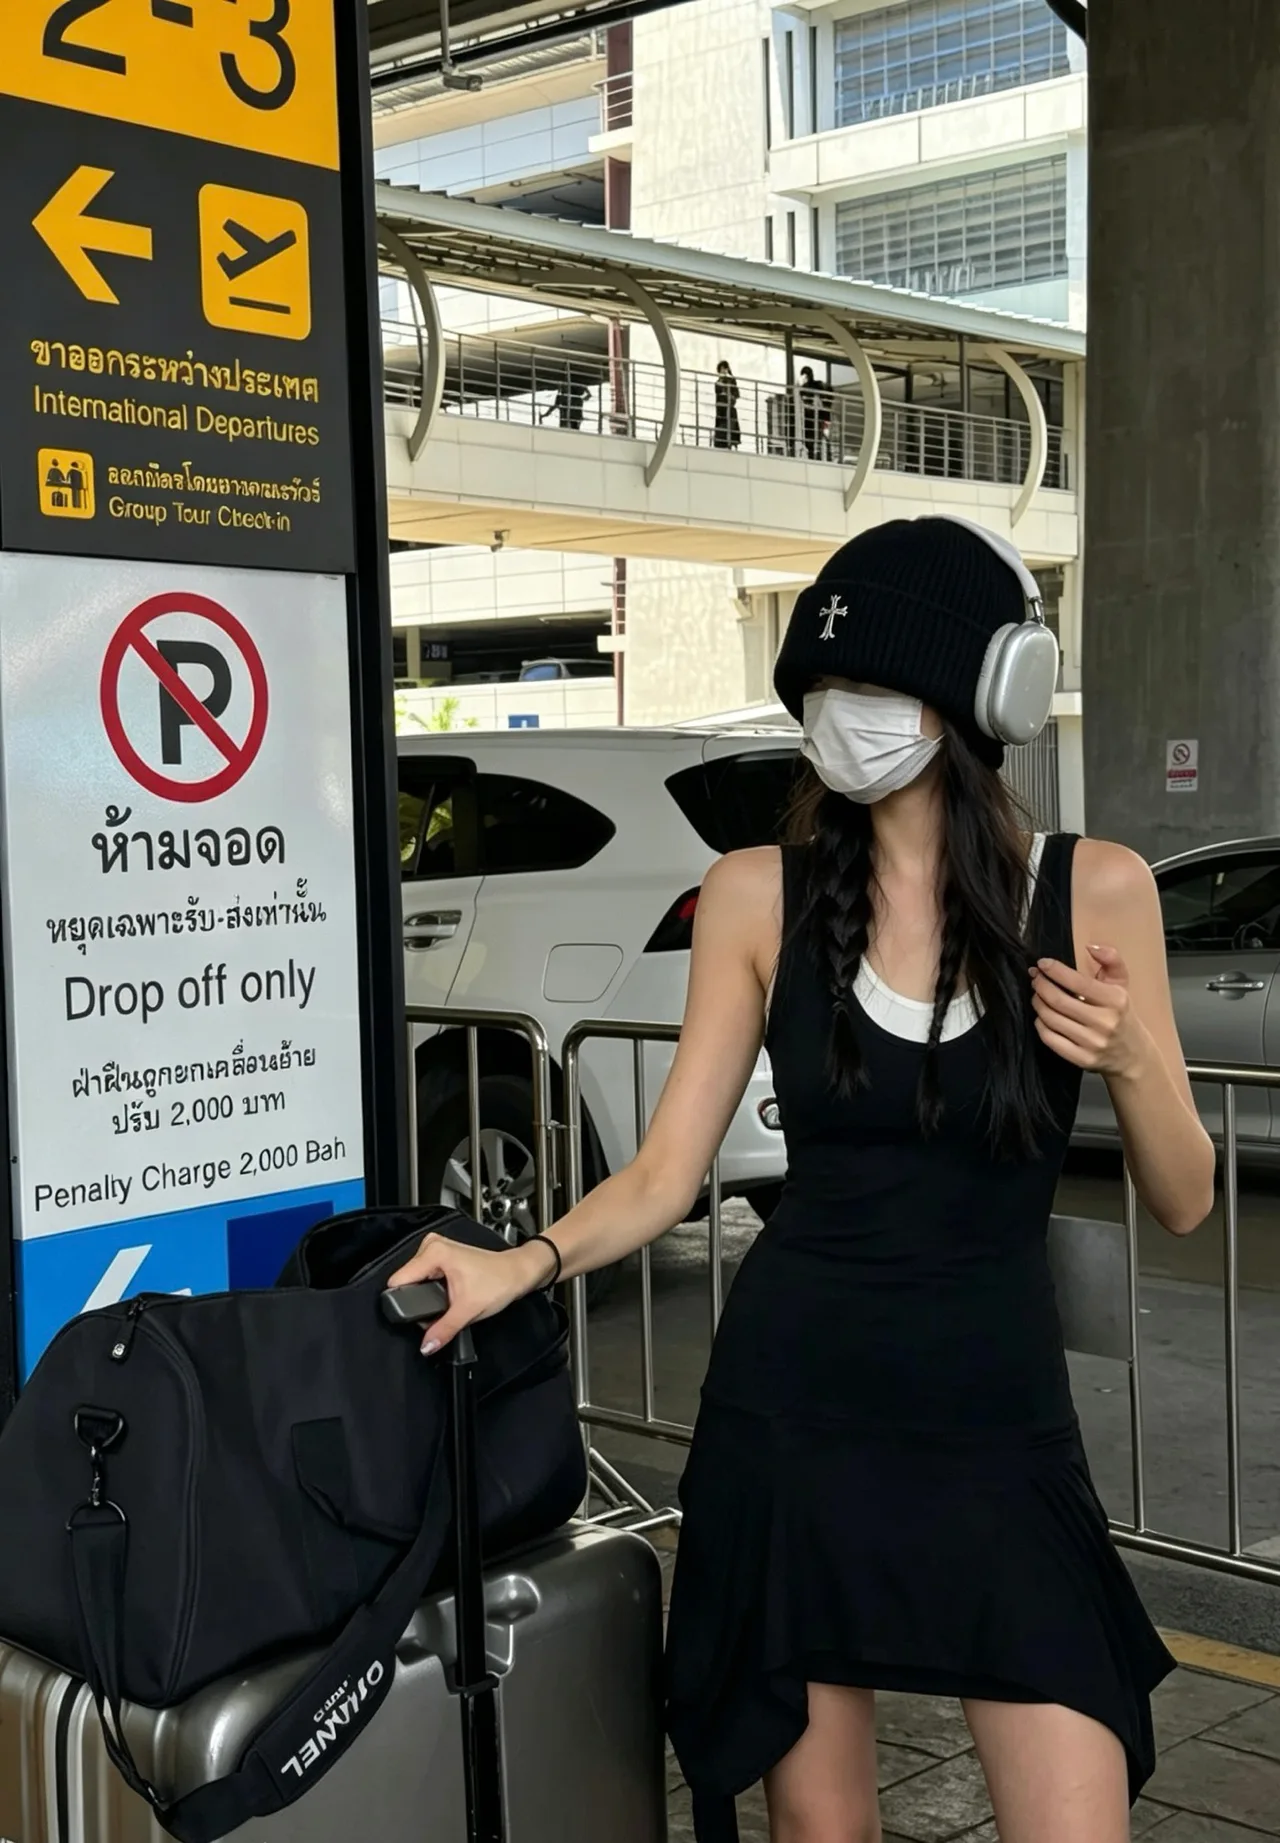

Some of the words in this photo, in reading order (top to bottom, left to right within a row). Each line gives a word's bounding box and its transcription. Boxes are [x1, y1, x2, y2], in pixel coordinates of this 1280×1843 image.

[30, 339, 319, 403] ขาออกระหว่างประเทศ
[34, 385, 188, 431] International
[196, 405, 320, 446] Departures
[108, 496, 167, 527] Group
[172, 501, 211, 526] Tour
[91, 804, 286, 874] ห้ามจอด
[46, 877, 327, 956] หยุดเฉพาะรับ-ส่งเท่านั้น
[65, 976, 164, 1024] Drop
[177, 962, 228, 1009] off
[240, 958, 316, 1010] only
[170, 1094, 234, 1126] 2,000
[34, 1173, 133, 1212] Penalty
[141, 1159, 232, 1190] Charge
[239, 1144, 299, 1177] 2,000
